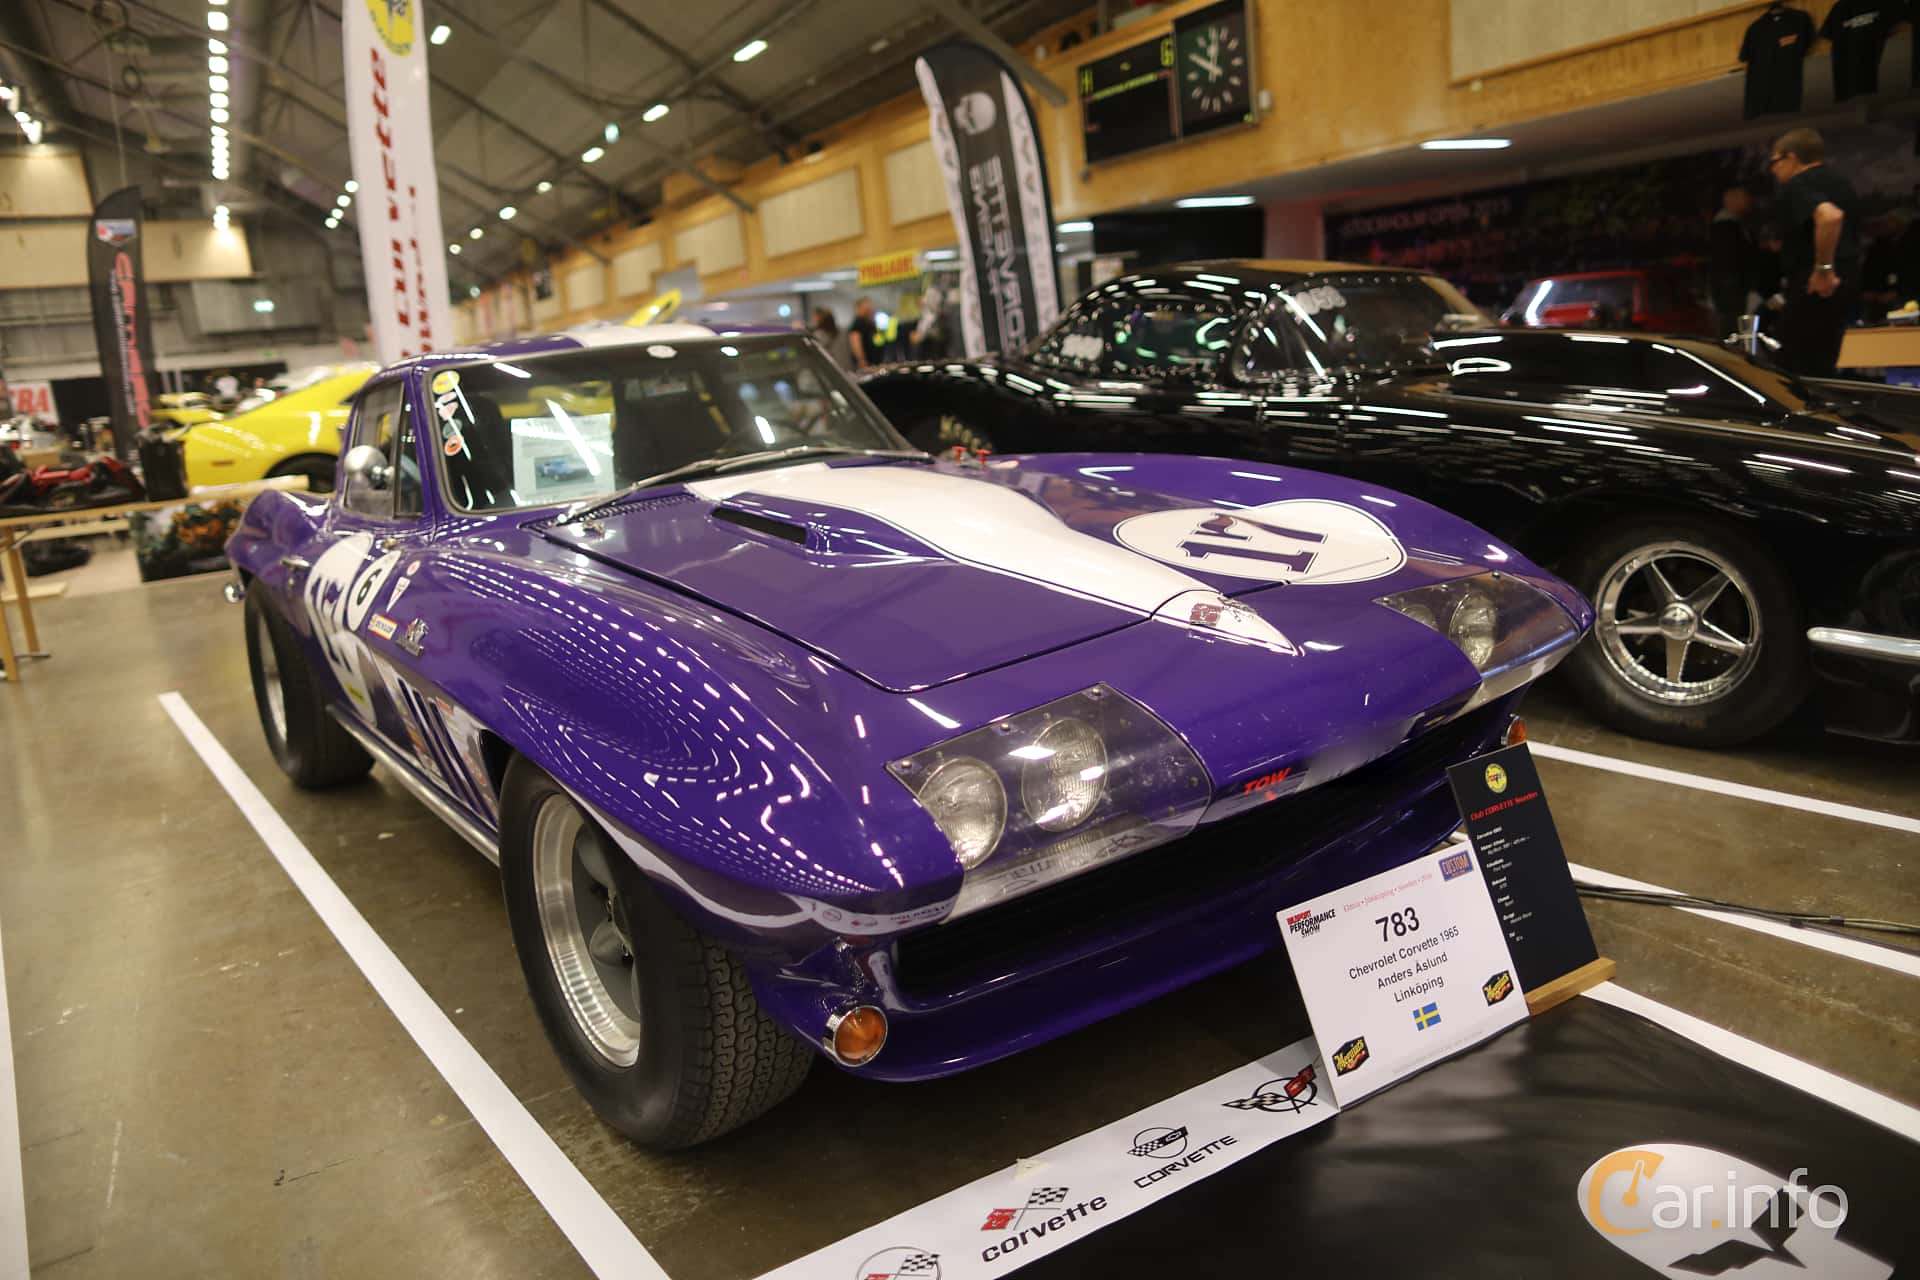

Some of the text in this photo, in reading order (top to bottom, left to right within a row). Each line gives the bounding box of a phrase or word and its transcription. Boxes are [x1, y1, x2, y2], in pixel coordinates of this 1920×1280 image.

[1176, 510, 1328, 574] 17
[1244, 767, 1292, 797] TOW
[1289, 909, 1336, 934] PERFORMANCE
[1301, 924, 1321, 938] SHOW
[1374, 906, 1420, 943] 783
[1348, 925, 1460, 980] Chevrolet Corvette 1965
[1377, 952, 1448, 989] Anders Åslund
[1393, 975, 1444, 1003] Linköping
[1133, 1135, 1238, 1189] CORVETTE
[980, 1193, 1109, 1264] corvette
